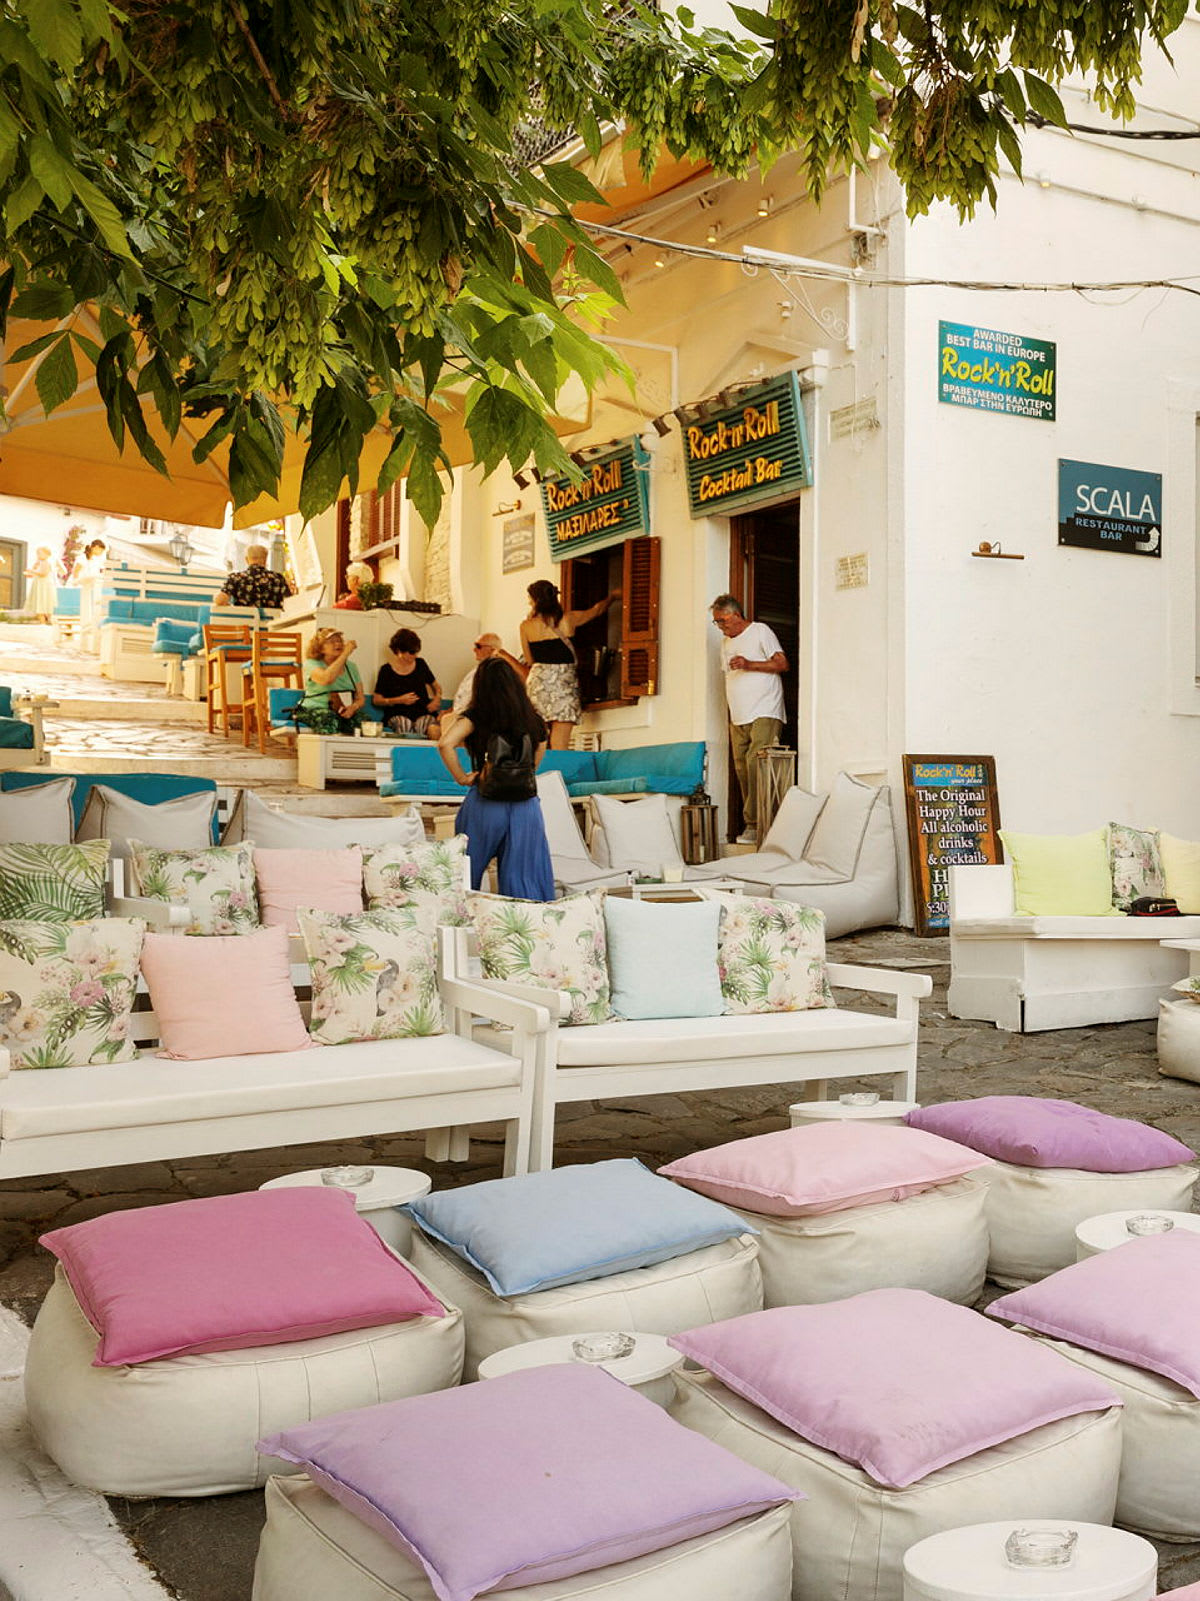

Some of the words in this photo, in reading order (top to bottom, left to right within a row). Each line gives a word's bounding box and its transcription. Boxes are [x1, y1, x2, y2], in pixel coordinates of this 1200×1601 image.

[973, 329, 1023, 347] AWARDED
[946, 333, 972, 348] BEST
[973, 339, 994, 352] BAR
[995, 344, 1005, 355] IN
[1007, 347, 1046, 363] EUROPE
[951, 394, 979, 405] ΜΠΑΡ
[980, 399, 1004, 410] ΣΤΗΝ
[1006, 403, 1042, 417] ΕΥΡΩΠΗ
[1006, 394, 1053, 411] ΚΑΛΥΤΕΡΟ
[700, 459, 754, 501] Cocktail
[755, 457, 783, 483] Bar
[1076, 484, 1156, 522] SCALA
[1075, 517, 1148, 535] RESTAURANT
[1100, 530, 1123, 541] BAR
[916, 789, 938, 802] The
[940, 789, 985, 805] Original
[919, 805, 956, 820] Happy
[958, 805, 986, 817] Hour
[920, 822, 938, 834] All
[940, 822, 988, 833] alcoholic
[938, 837, 974, 849] drinks
[927, 854, 938, 865] &
[940, 854, 988, 865] cocktails
